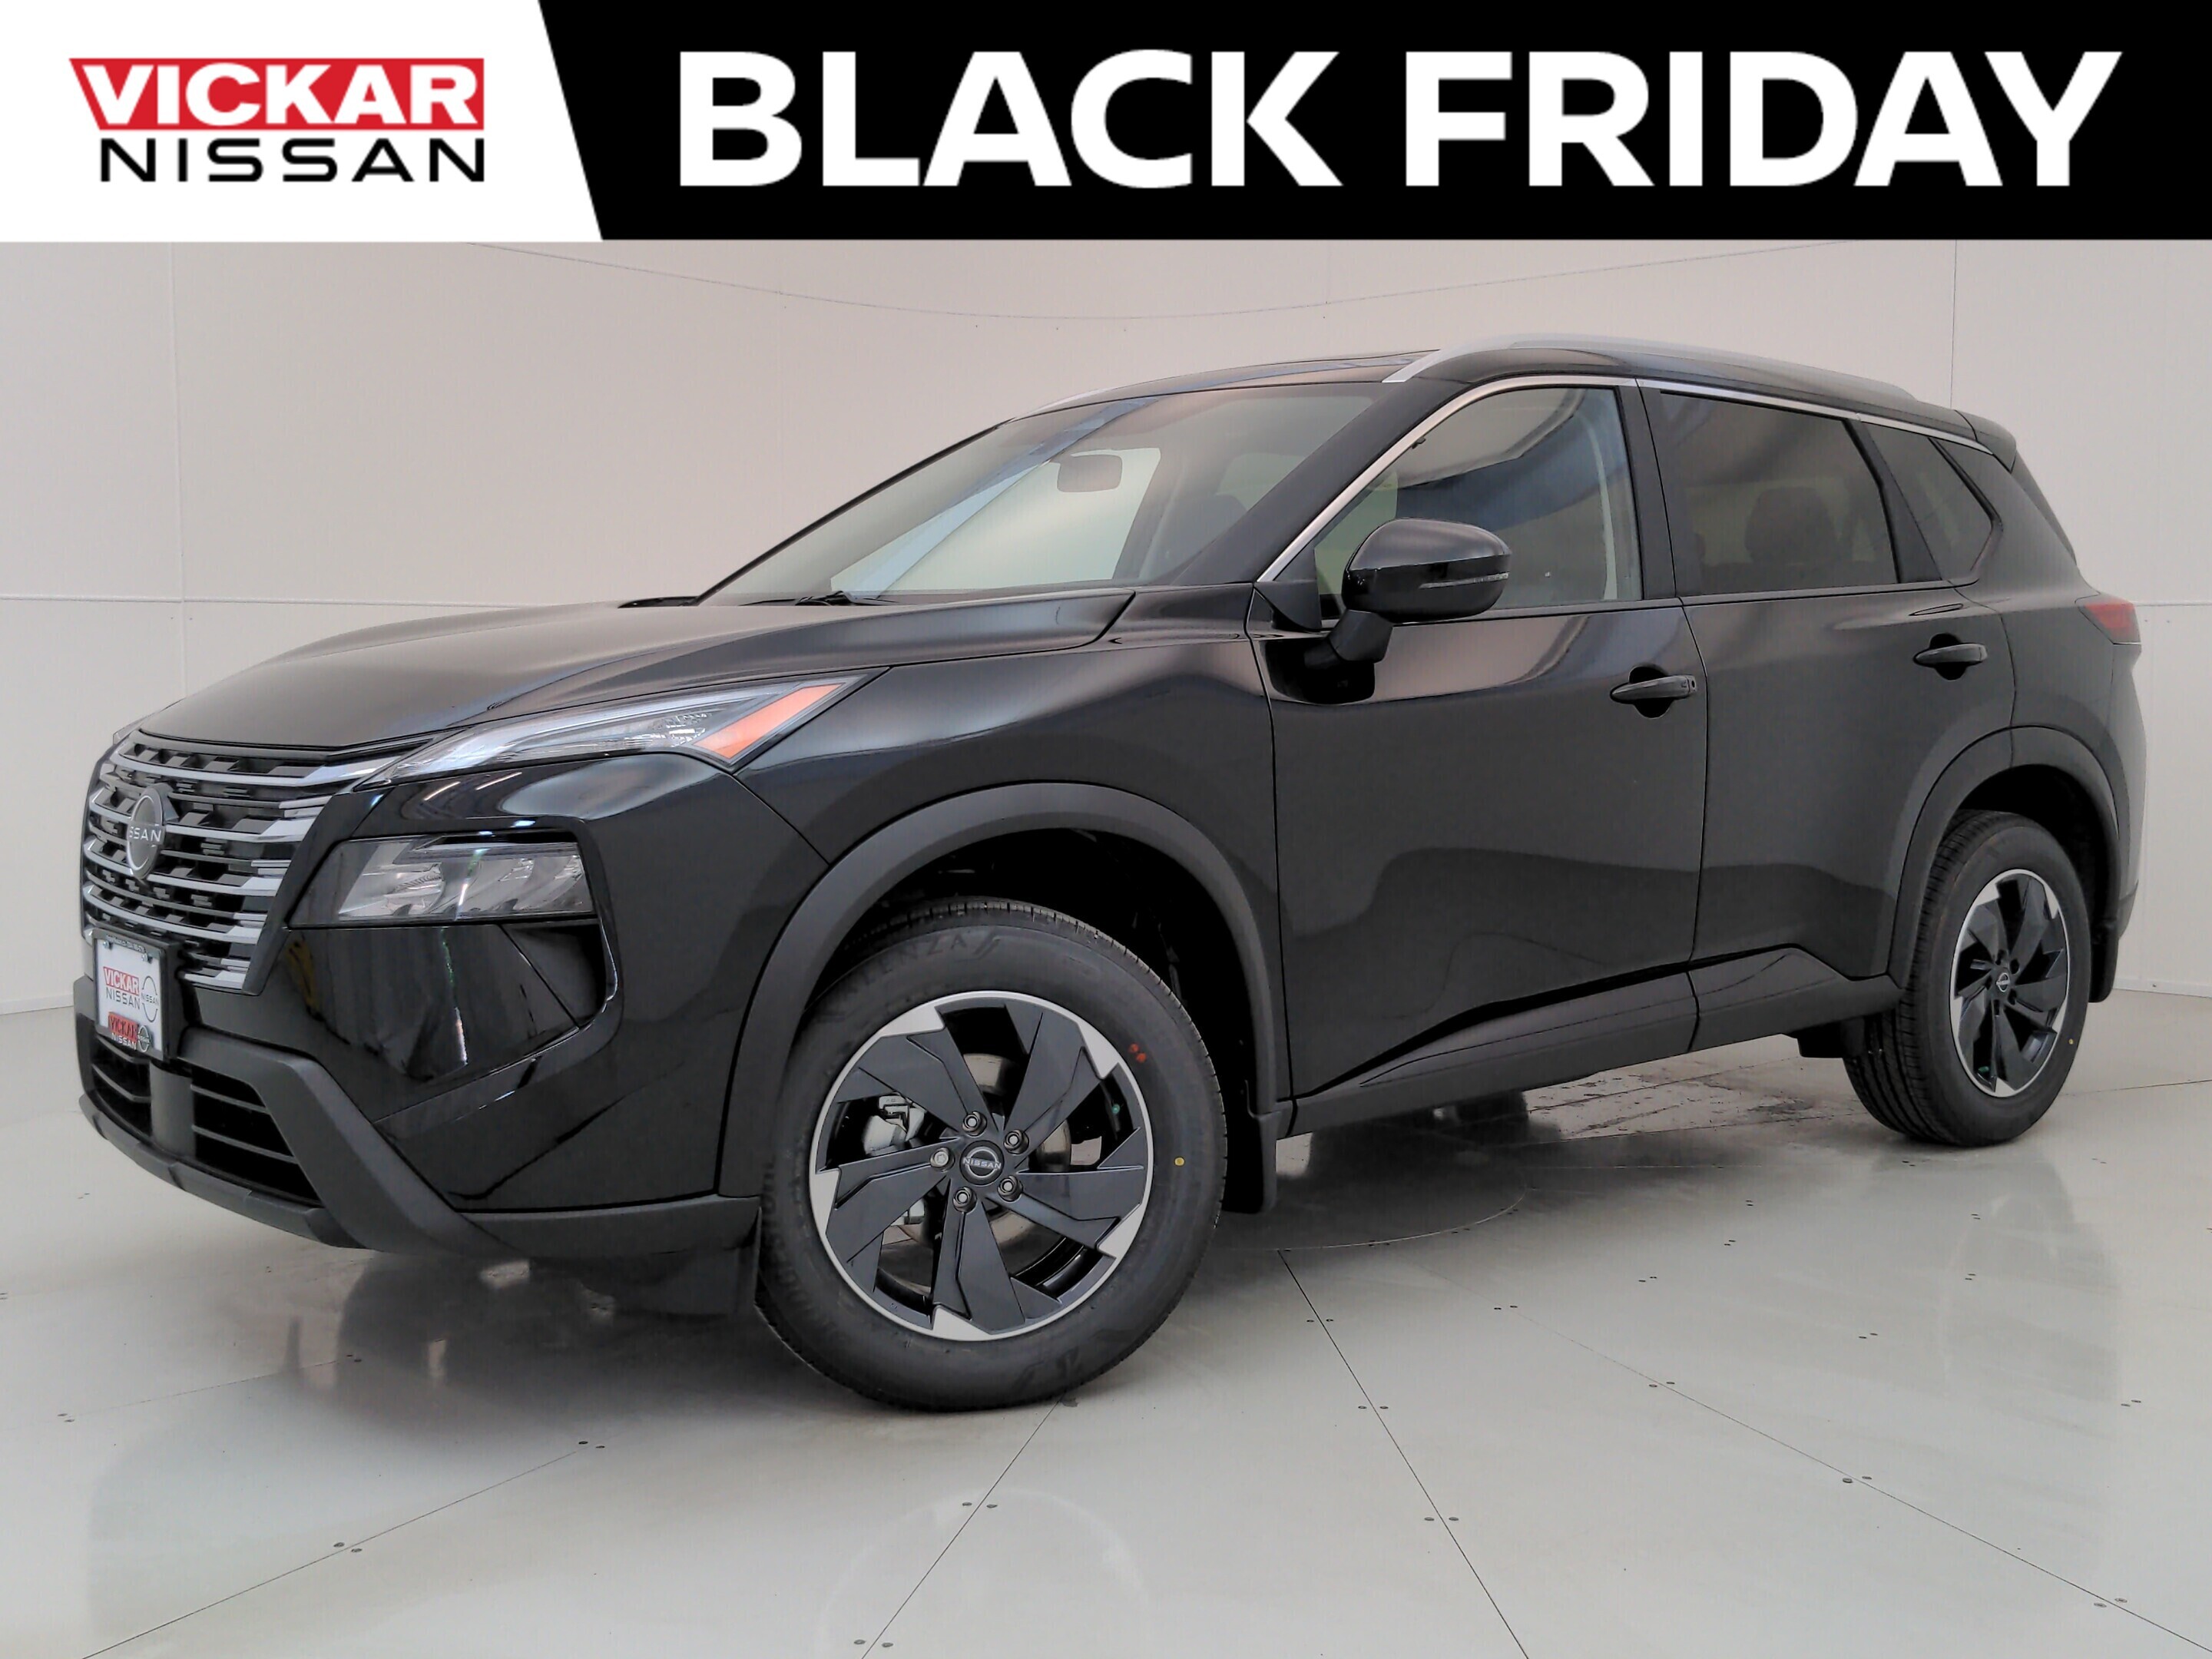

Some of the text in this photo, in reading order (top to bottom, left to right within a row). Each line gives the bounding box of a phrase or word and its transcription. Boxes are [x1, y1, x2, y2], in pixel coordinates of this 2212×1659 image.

[128, 826, 162, 843] SSAN
[104, 968, 139, 995] VICKAR
[106, 987, 140, 1010] NISSAN
[141, 992, 159, 1006] NISSAN
[110, 1015, 138, 1042] VICKAR
[111, 1032, 137, 1050] NISSAN
[962, 1157, 1002, 1169] NISSAN
